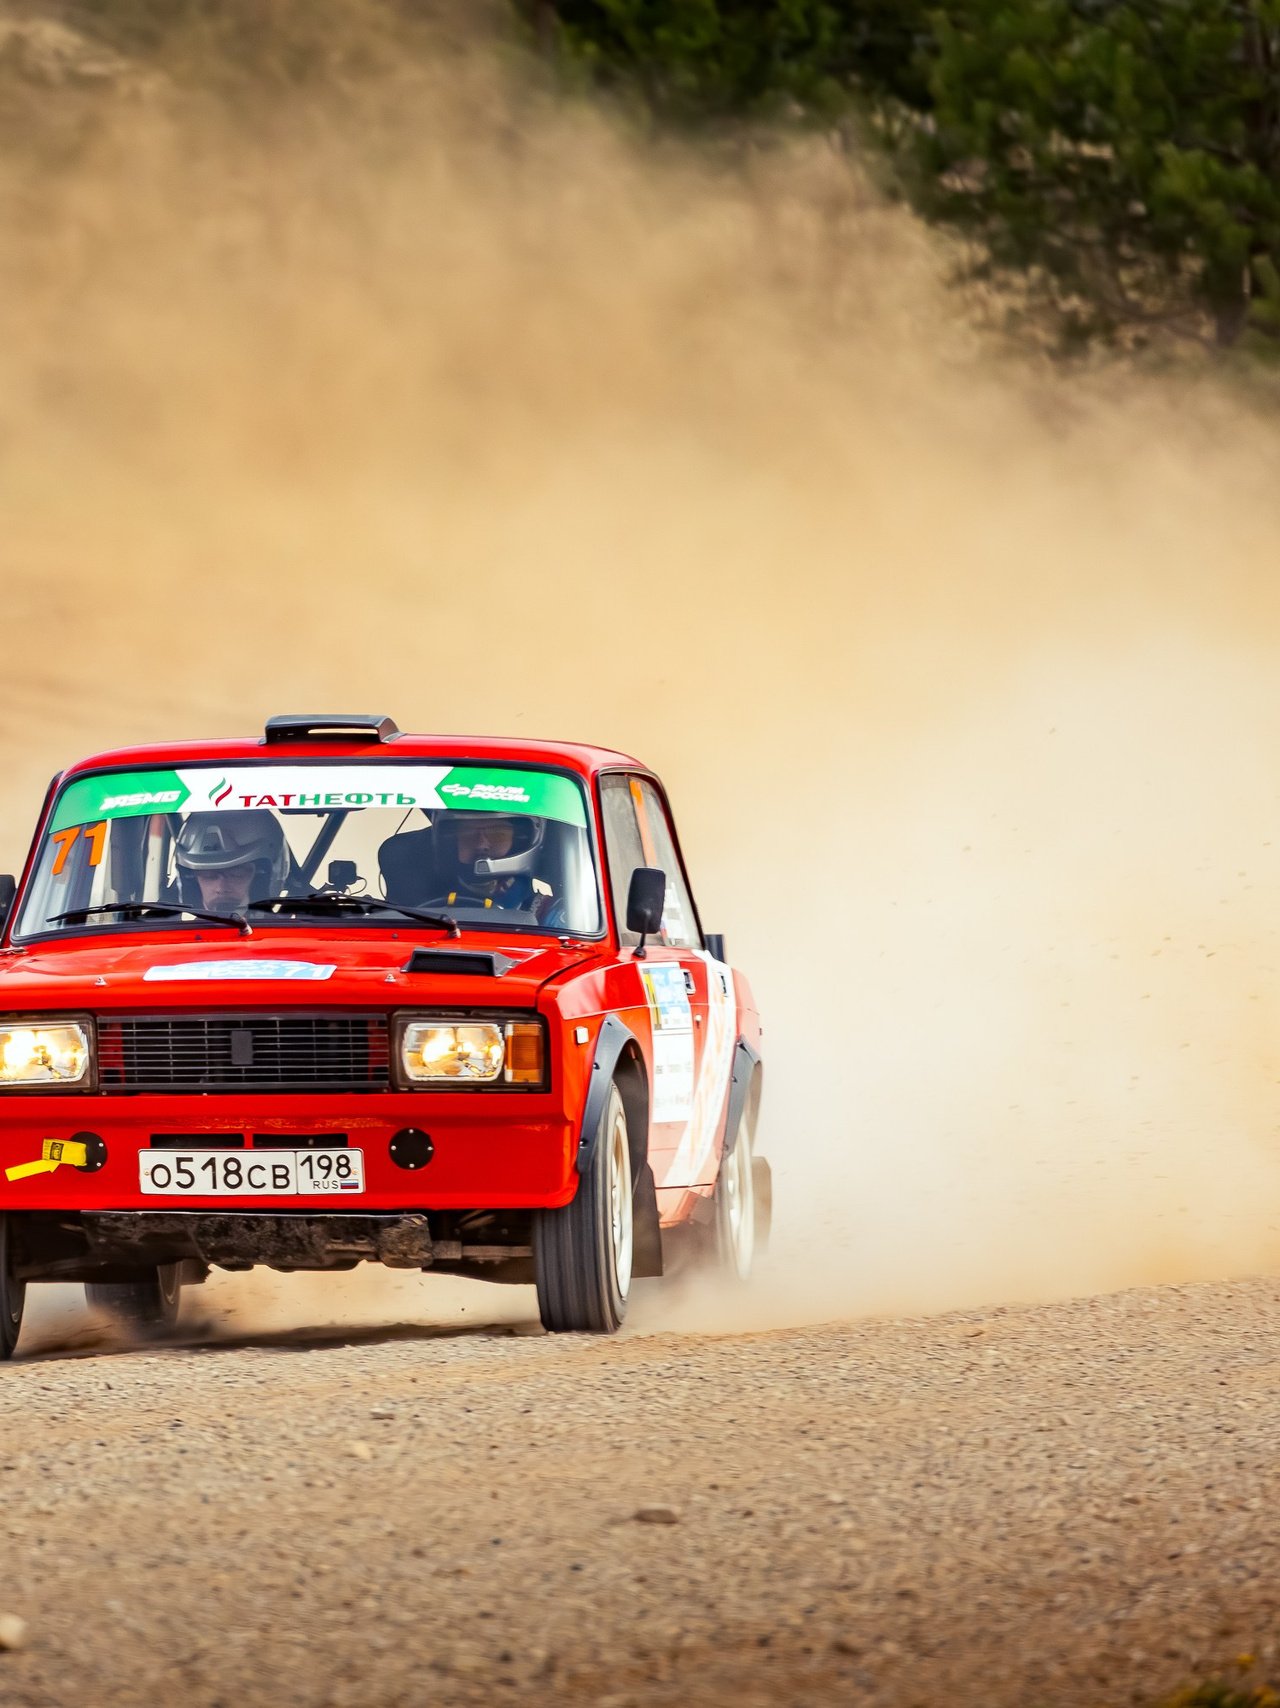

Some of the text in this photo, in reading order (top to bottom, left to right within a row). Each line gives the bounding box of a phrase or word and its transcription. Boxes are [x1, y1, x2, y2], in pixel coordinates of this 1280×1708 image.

[239, 793, 417, 808] ТАТНЕФТЬ
[51, 821, 108, 875] 71
[283, 966, 326, 978] 71
[150, 1154, 352, 1190] О518СВ 198
[312, 1180, 339, 1190] RUS
